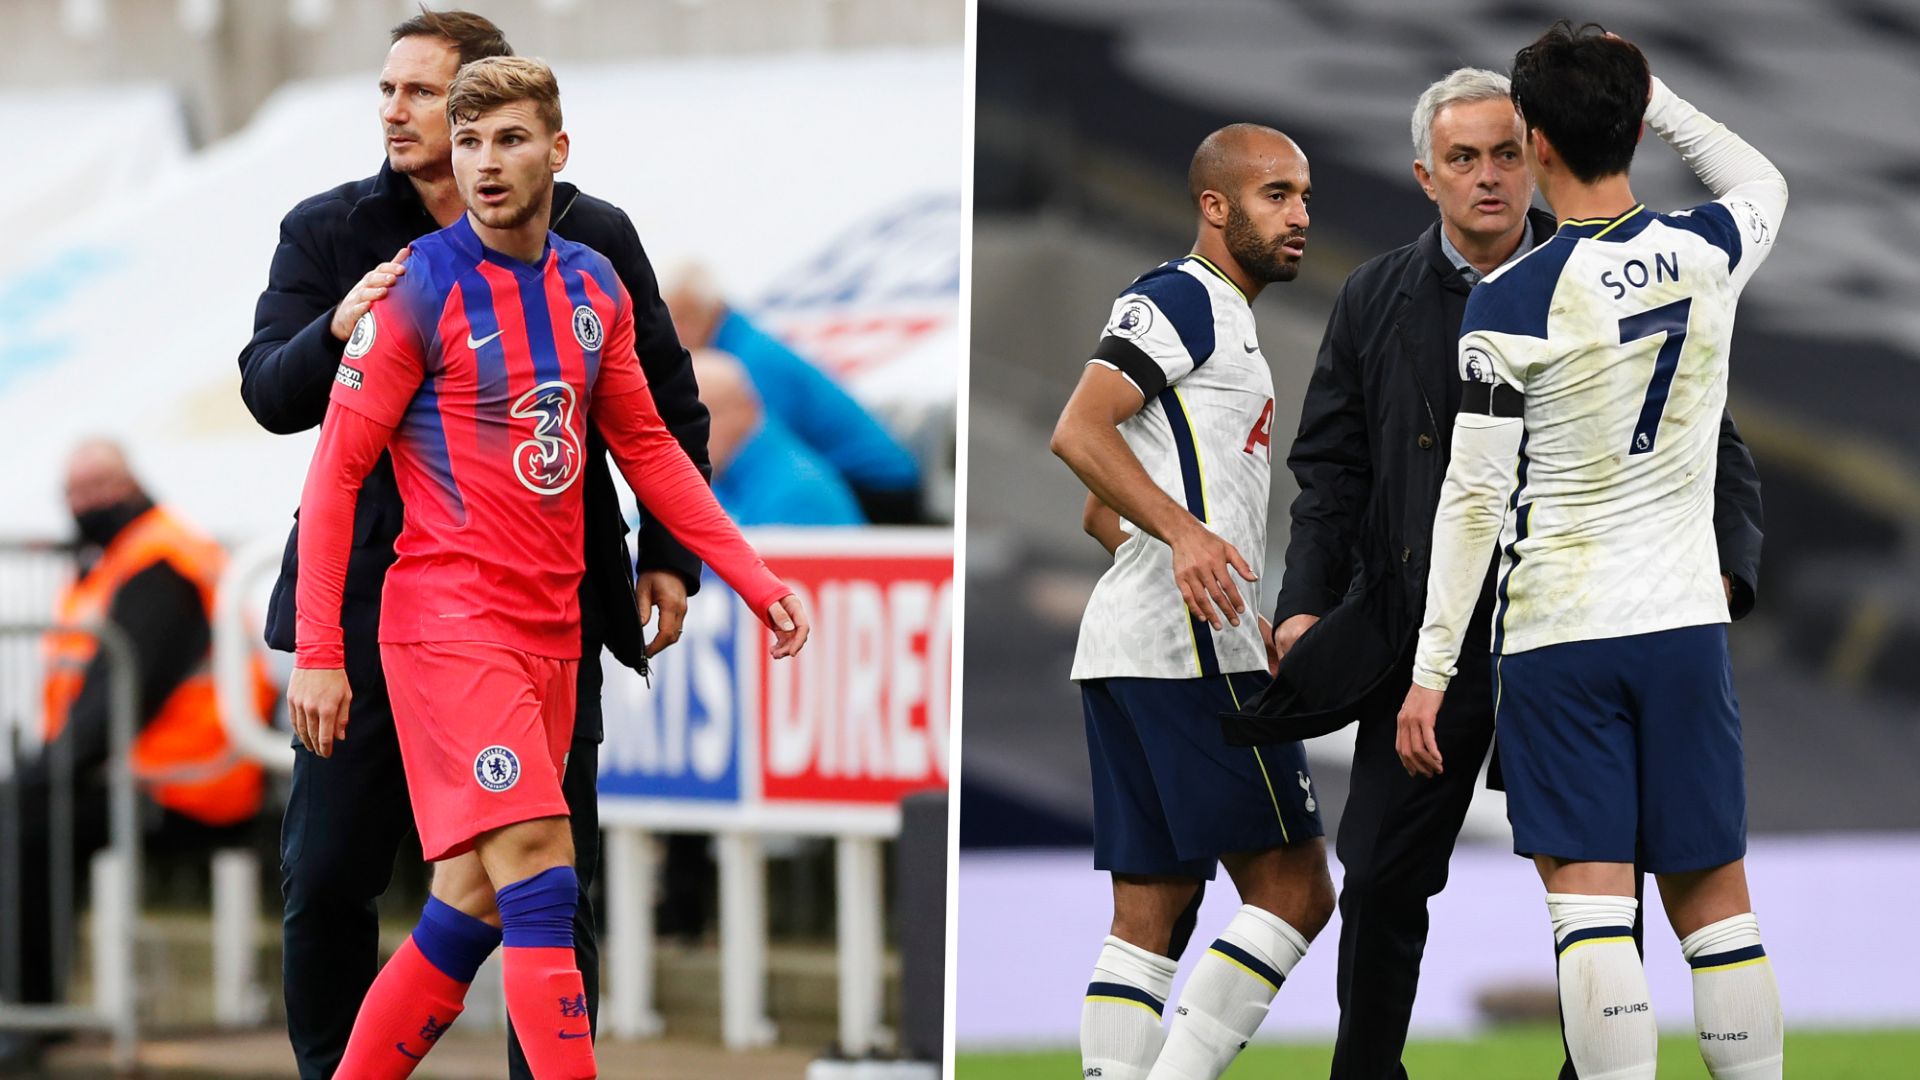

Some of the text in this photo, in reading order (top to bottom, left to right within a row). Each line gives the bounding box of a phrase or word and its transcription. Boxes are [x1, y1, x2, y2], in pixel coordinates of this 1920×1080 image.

[1601, 252, 1680, 300] SON
[1618, 297, 1692, 455] 7
[1603, 1002, 1648, 1016] SPURS
[1700, 1031, 1749, 1041] SPURS
